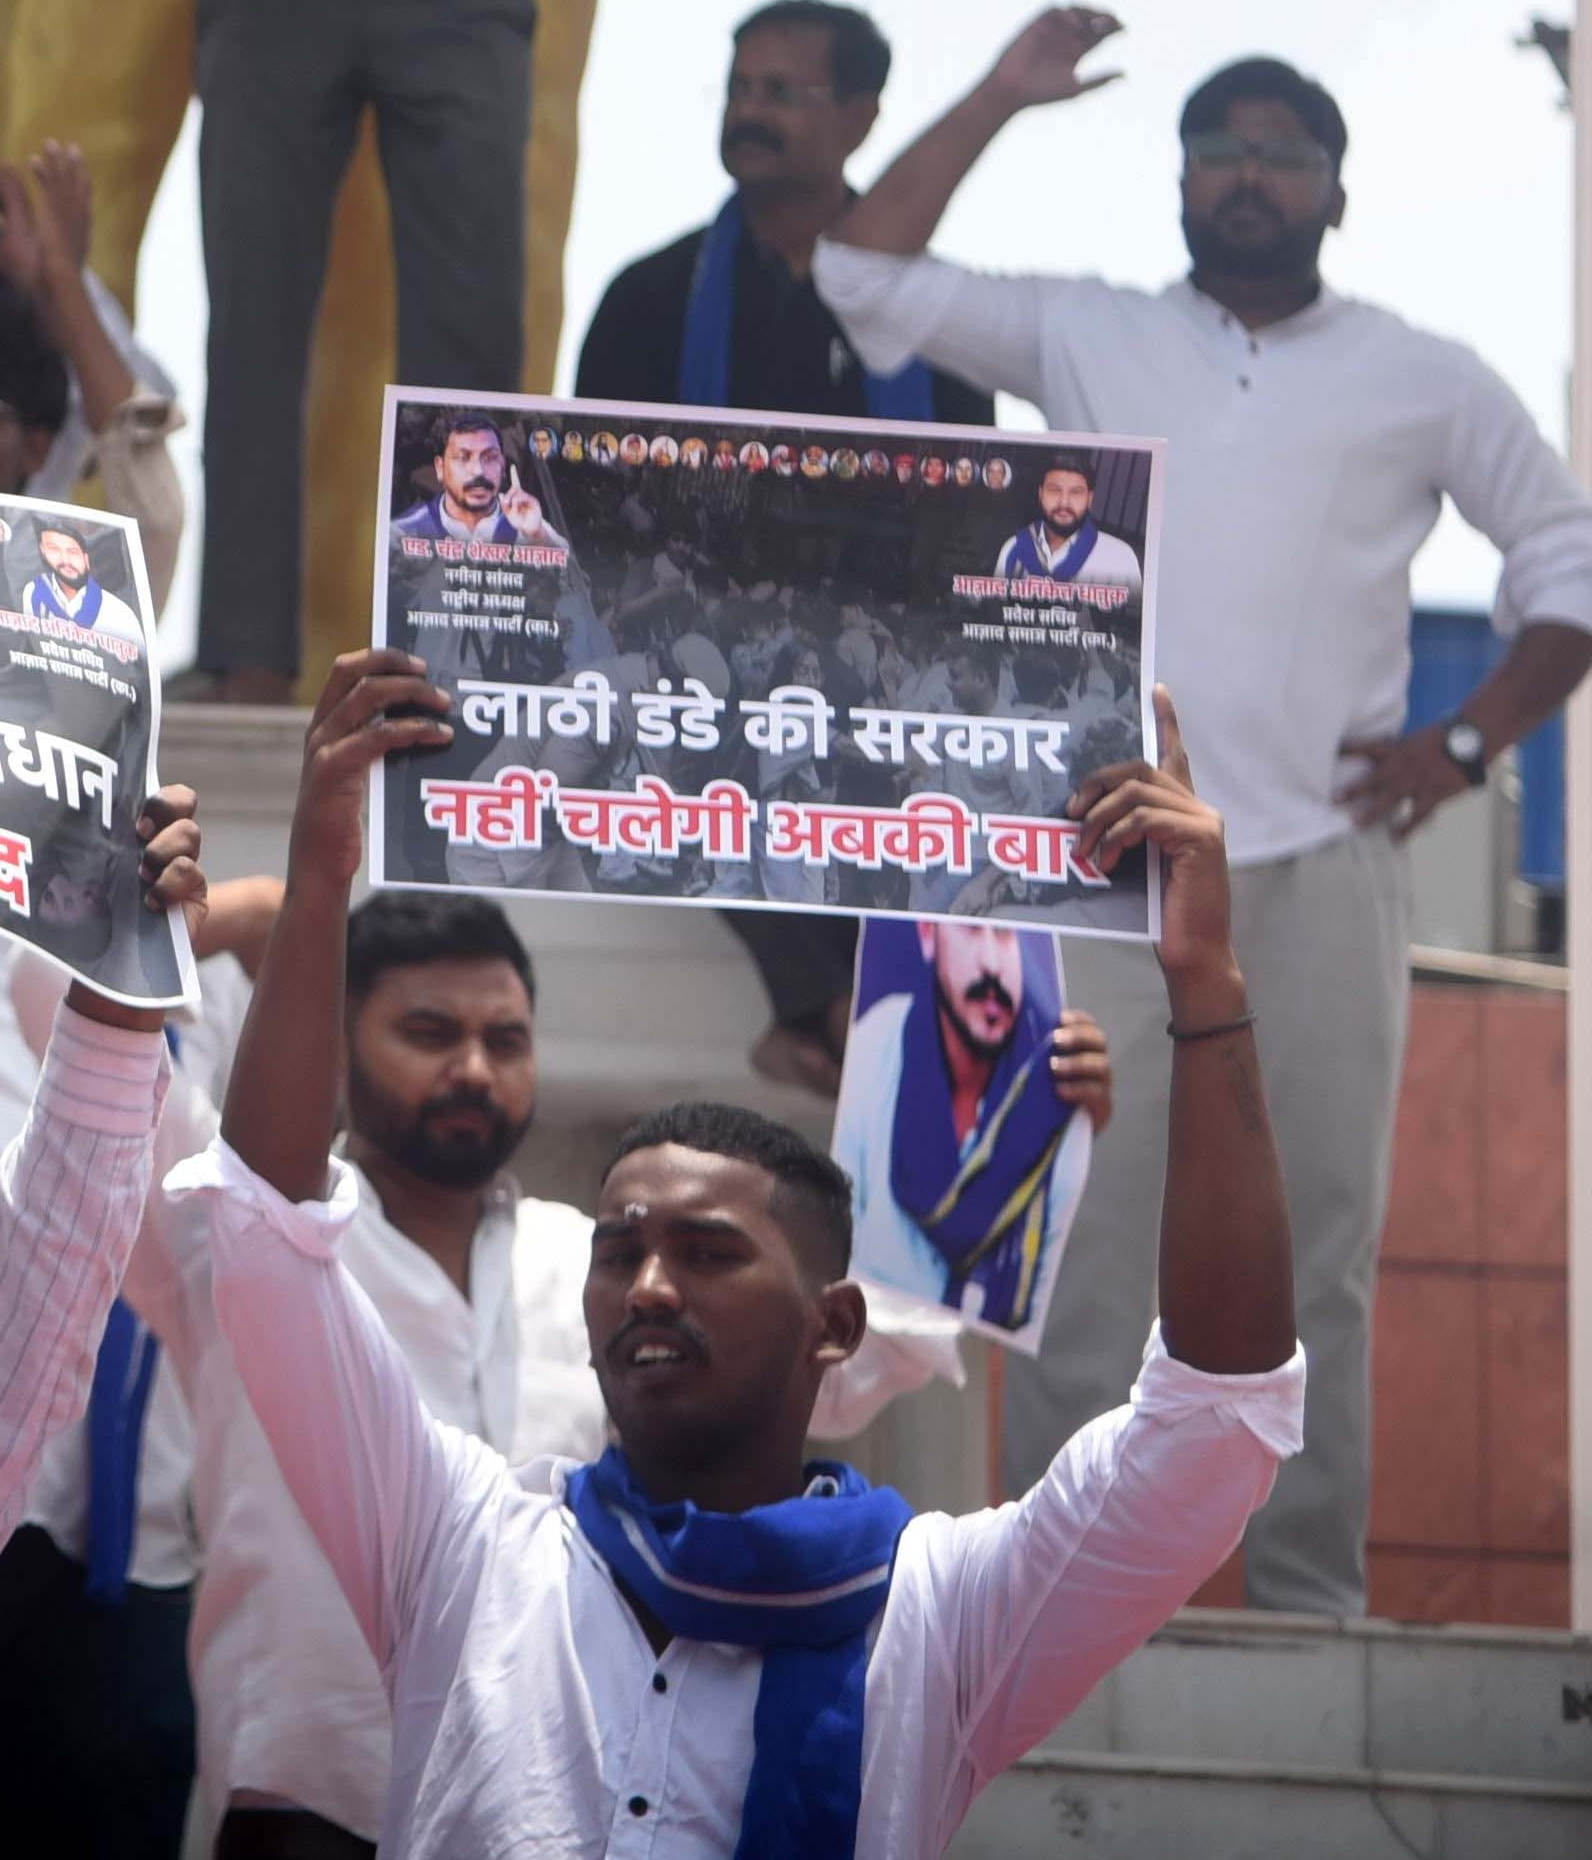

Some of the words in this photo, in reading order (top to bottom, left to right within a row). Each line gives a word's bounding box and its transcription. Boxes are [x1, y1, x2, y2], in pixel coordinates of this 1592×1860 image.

[451, 613, 490, 631] समाज
[1007, 626, 1047, 645] समाज
[458, 670, 618, 745] लाठी
[632, 677, 726, 751] डंडे
[739, 684, 836, 760] की
[849, 707, 1071, 774] सरकार
[421, 765, 558, 850] नहीं
[558, 774, 757, 862] चलेगी
[766, 791, 978, 876] अबकी
